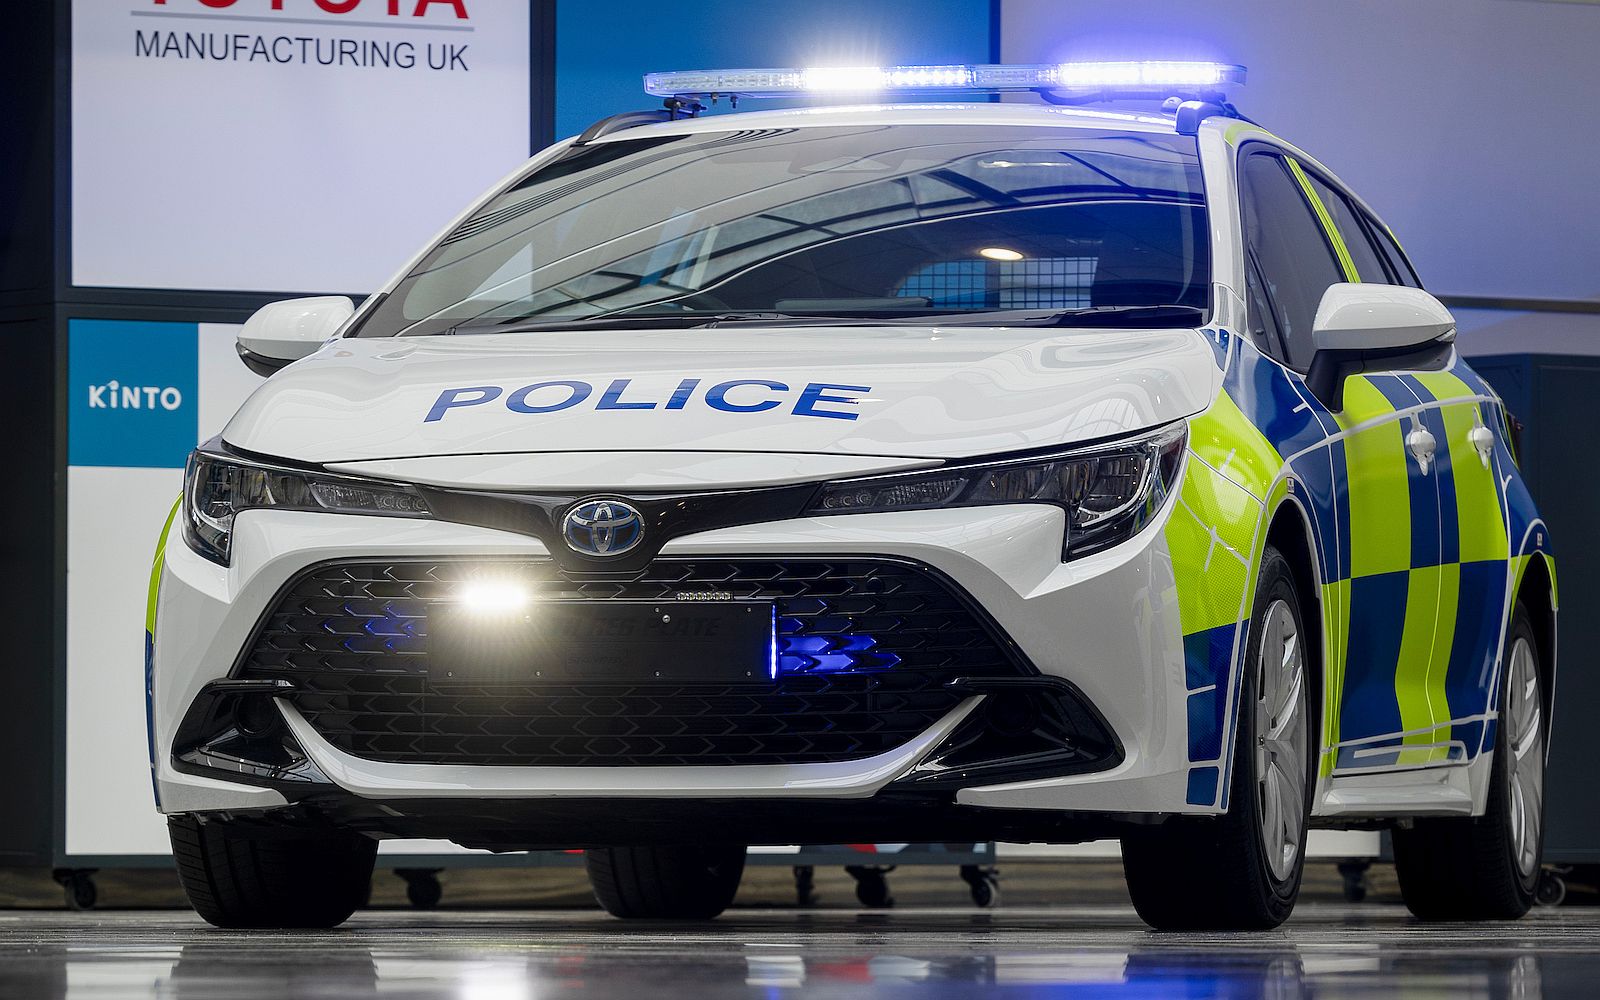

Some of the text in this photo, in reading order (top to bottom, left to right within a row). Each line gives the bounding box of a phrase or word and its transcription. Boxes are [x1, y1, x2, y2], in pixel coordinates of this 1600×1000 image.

[135, 29, 470, 72] MANUFACTURING UK
[423, 378, 872, 423] POLICE
